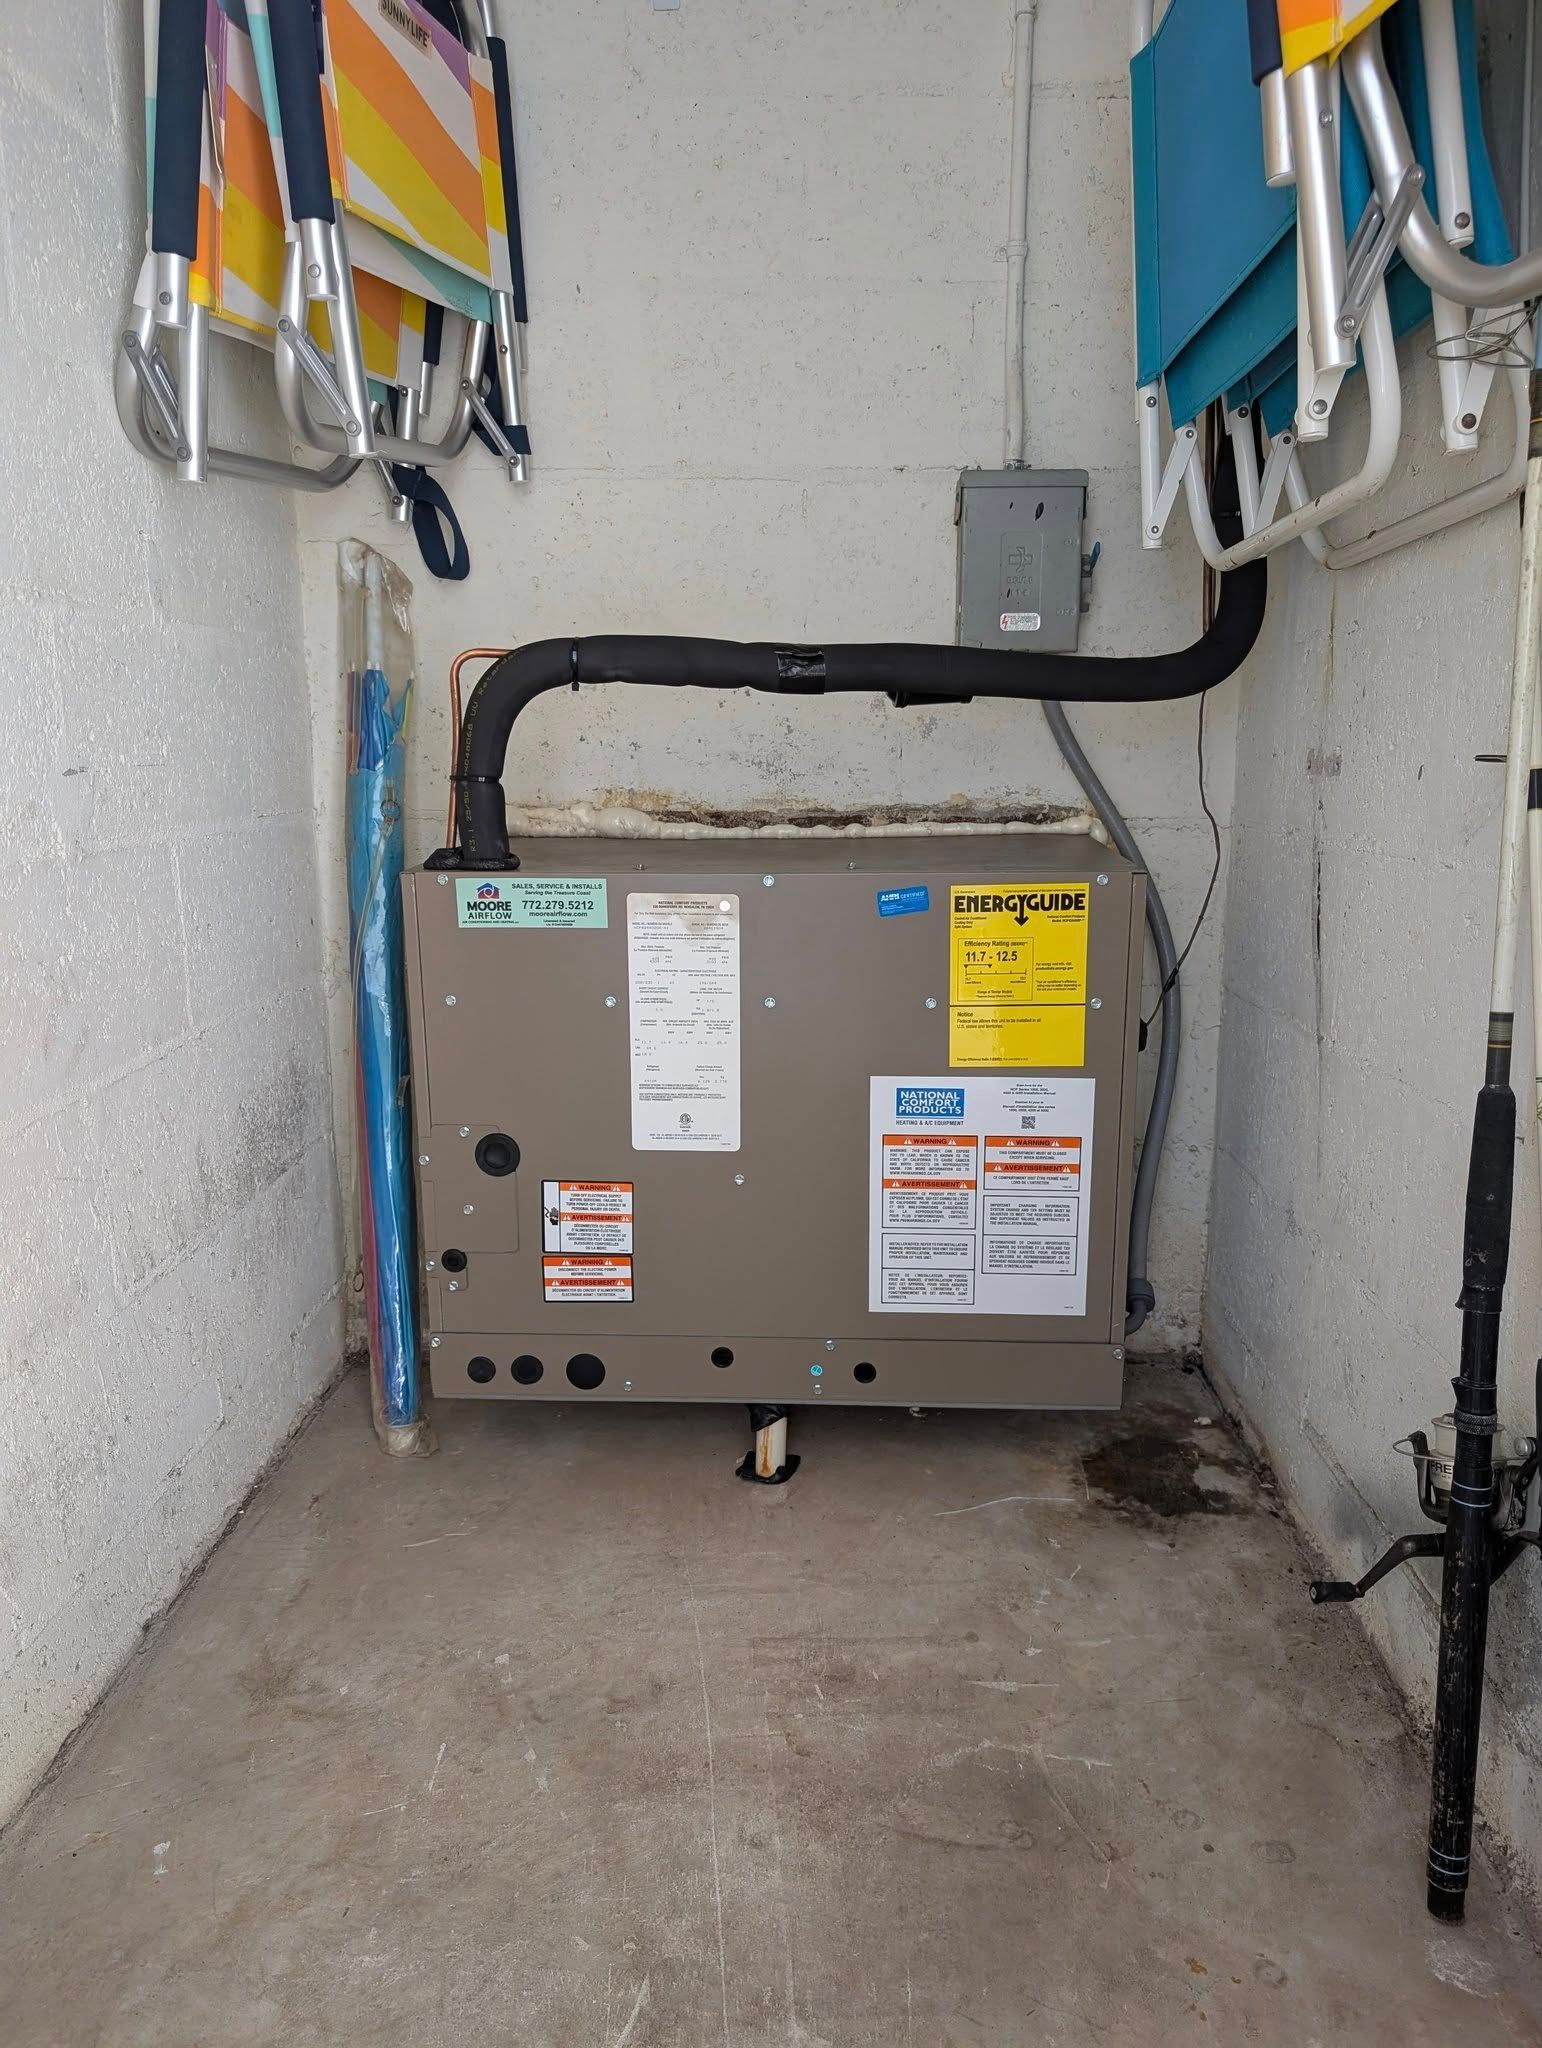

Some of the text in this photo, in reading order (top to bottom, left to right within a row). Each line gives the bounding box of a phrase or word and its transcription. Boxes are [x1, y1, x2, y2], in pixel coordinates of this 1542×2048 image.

[383, 0, 428, 48] SUNNYLIFE
[467, 902, 512, 911] MOORE
[522, 901, 594, 910] 772.279.5212
[954, 893, 1086, 912] ENERGYGUIDE
[966, 951, 986, 961] 11.7
[996, 951, 1017, 961] 12.5
[901, 1091, 960, 1099] NATIONAL
[902, 1099, 959, 1107] COMFORT
[899, 1106, 961, 1114] PRODUCTS
[1431, 1462, 1452, 1474] FRE
